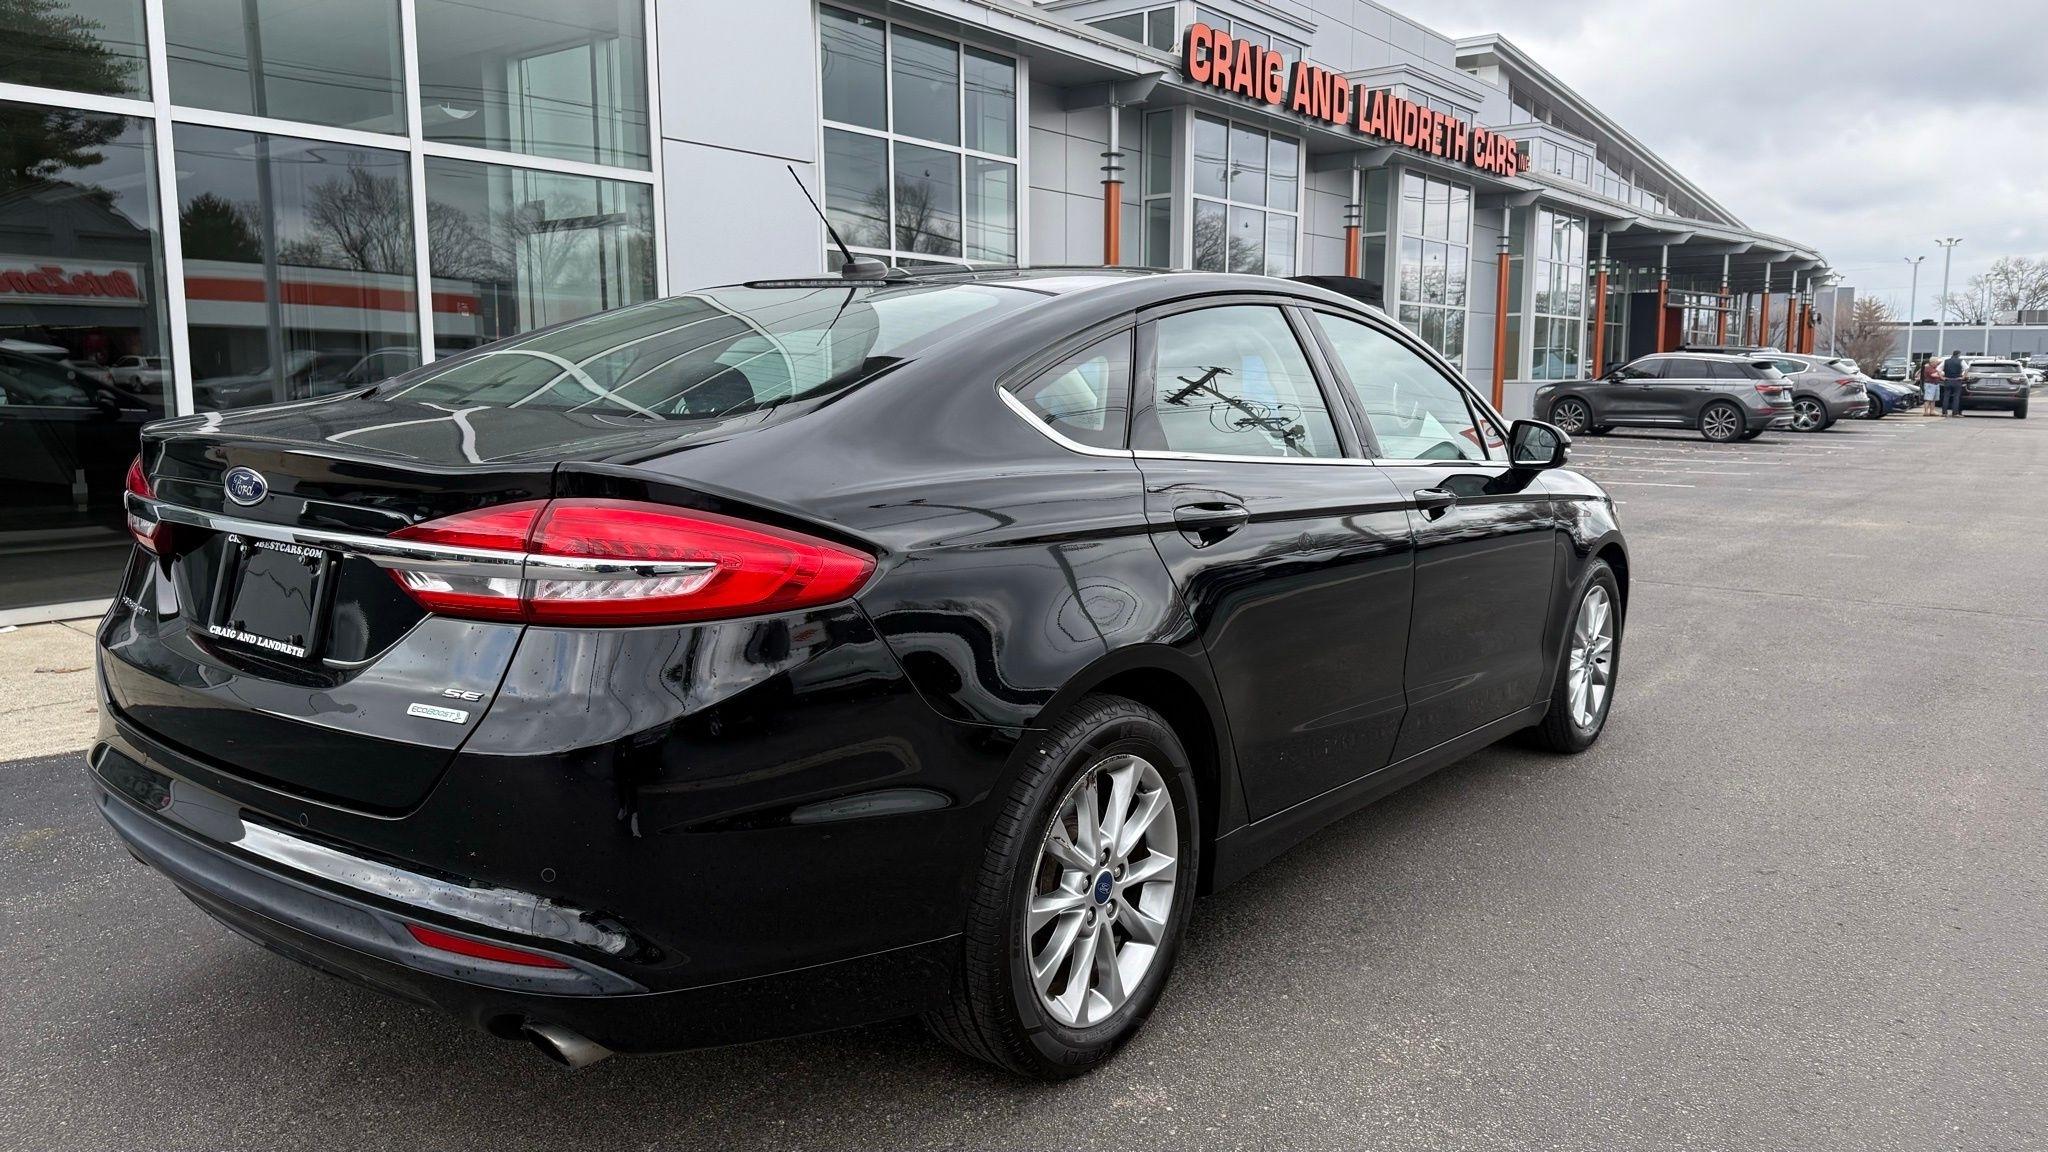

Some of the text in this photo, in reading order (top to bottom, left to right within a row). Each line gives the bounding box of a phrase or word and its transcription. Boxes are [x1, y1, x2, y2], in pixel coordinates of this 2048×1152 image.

[1186, 22, 1284, 105] CRAIG
[1291, 61, 1350, 126] AND
[1356, 83, 1468, 163] LANDRETH
[1472, 127, 1517, 177] CARS
[209, 625, 305, 658] CRAIG AND LANDRETH
[441, 688, 485, 702] SE
